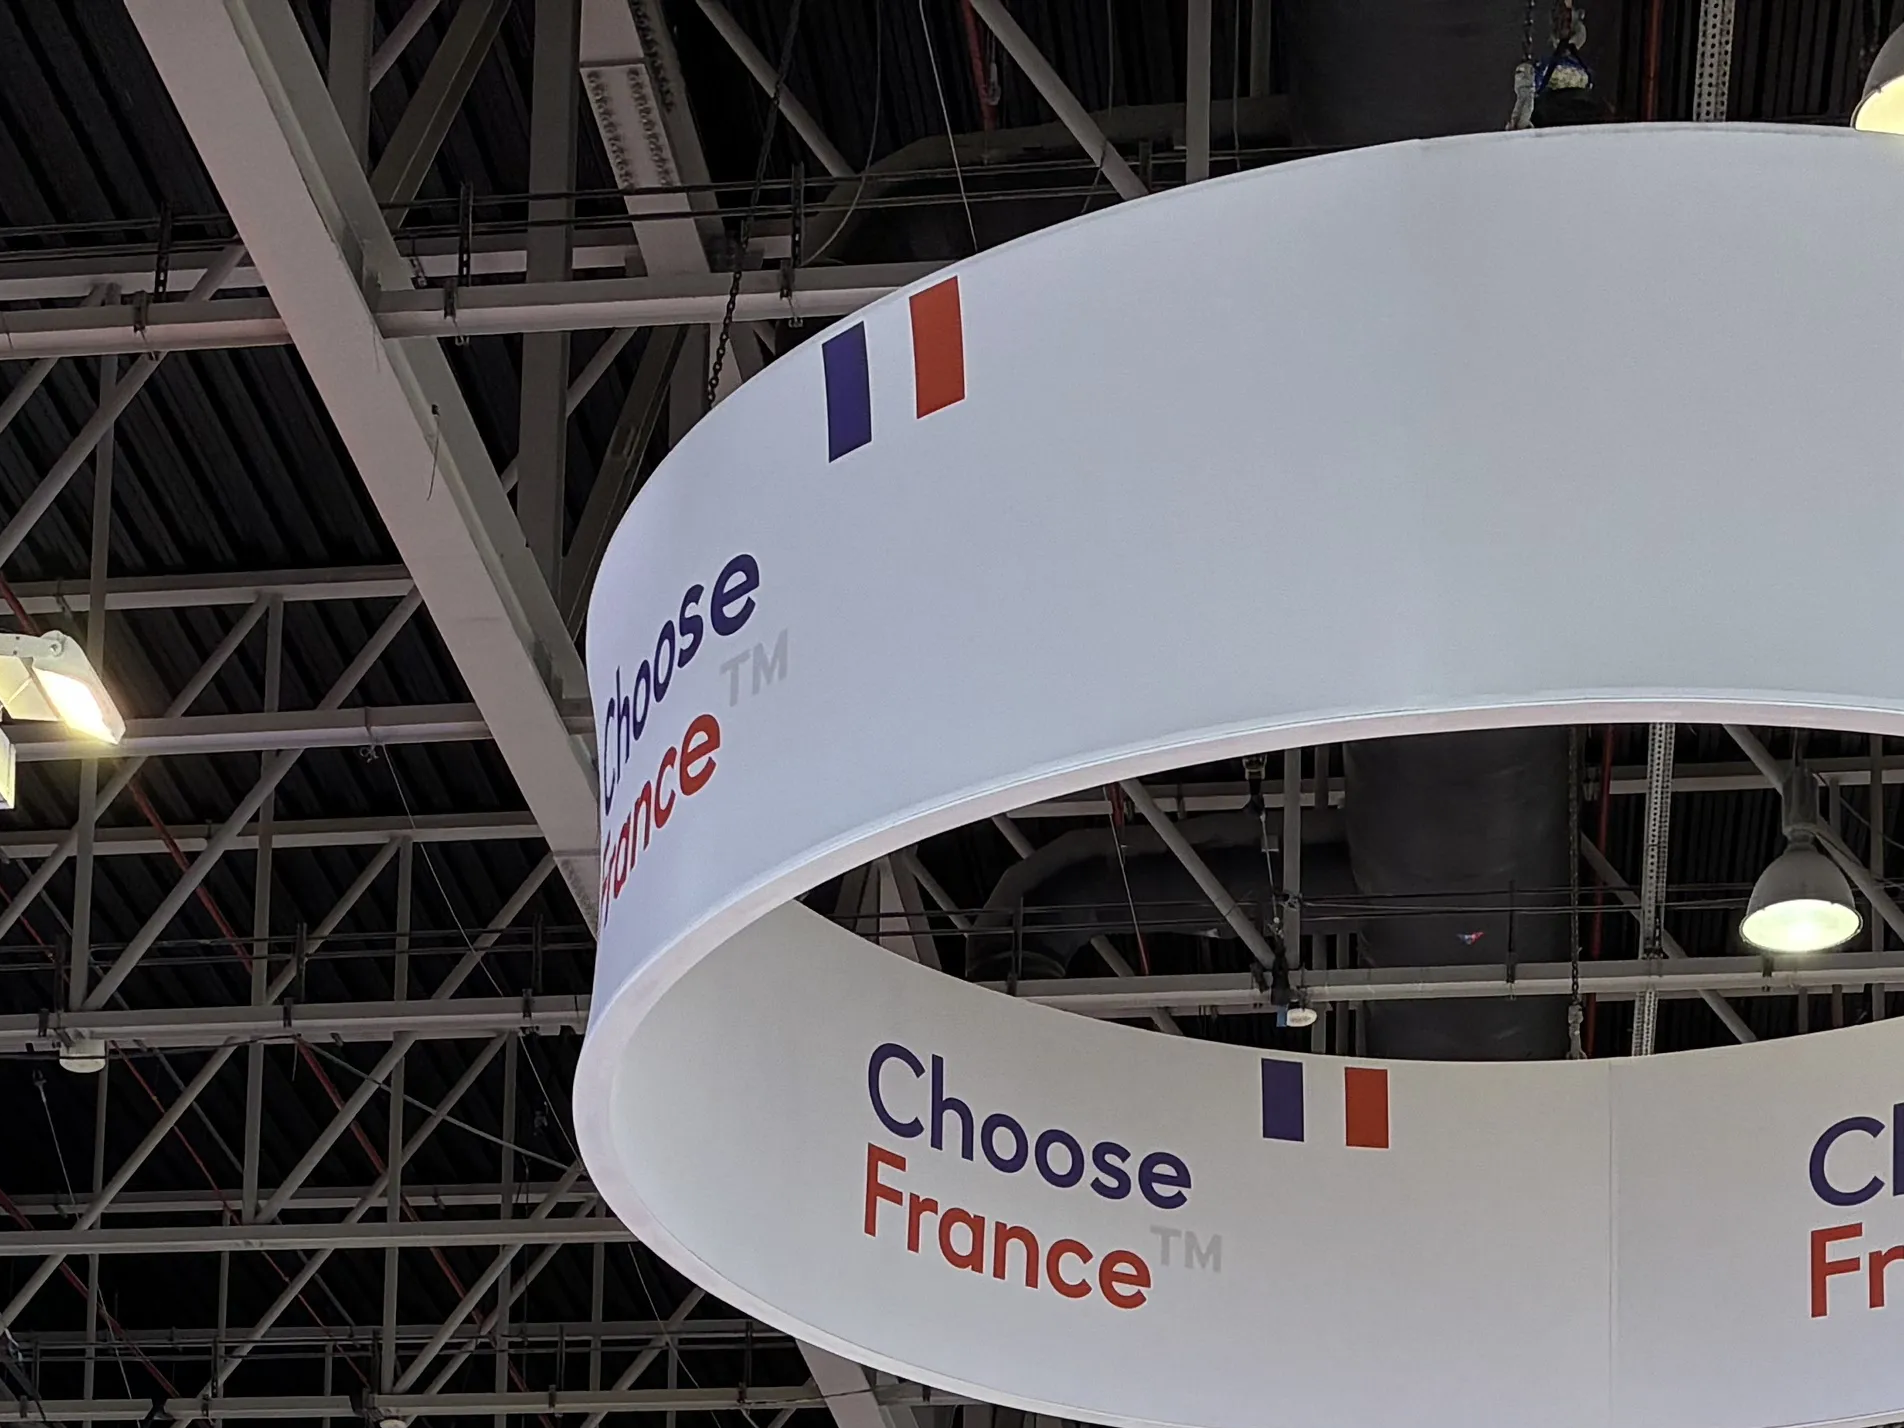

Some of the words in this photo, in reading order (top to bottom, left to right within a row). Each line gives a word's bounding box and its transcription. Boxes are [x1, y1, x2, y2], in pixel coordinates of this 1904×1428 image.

[604, 554, 759, 813] Choose
[868, 1042, 1192, 1209] Choose
[865, 1142, 1151, 1309] France
